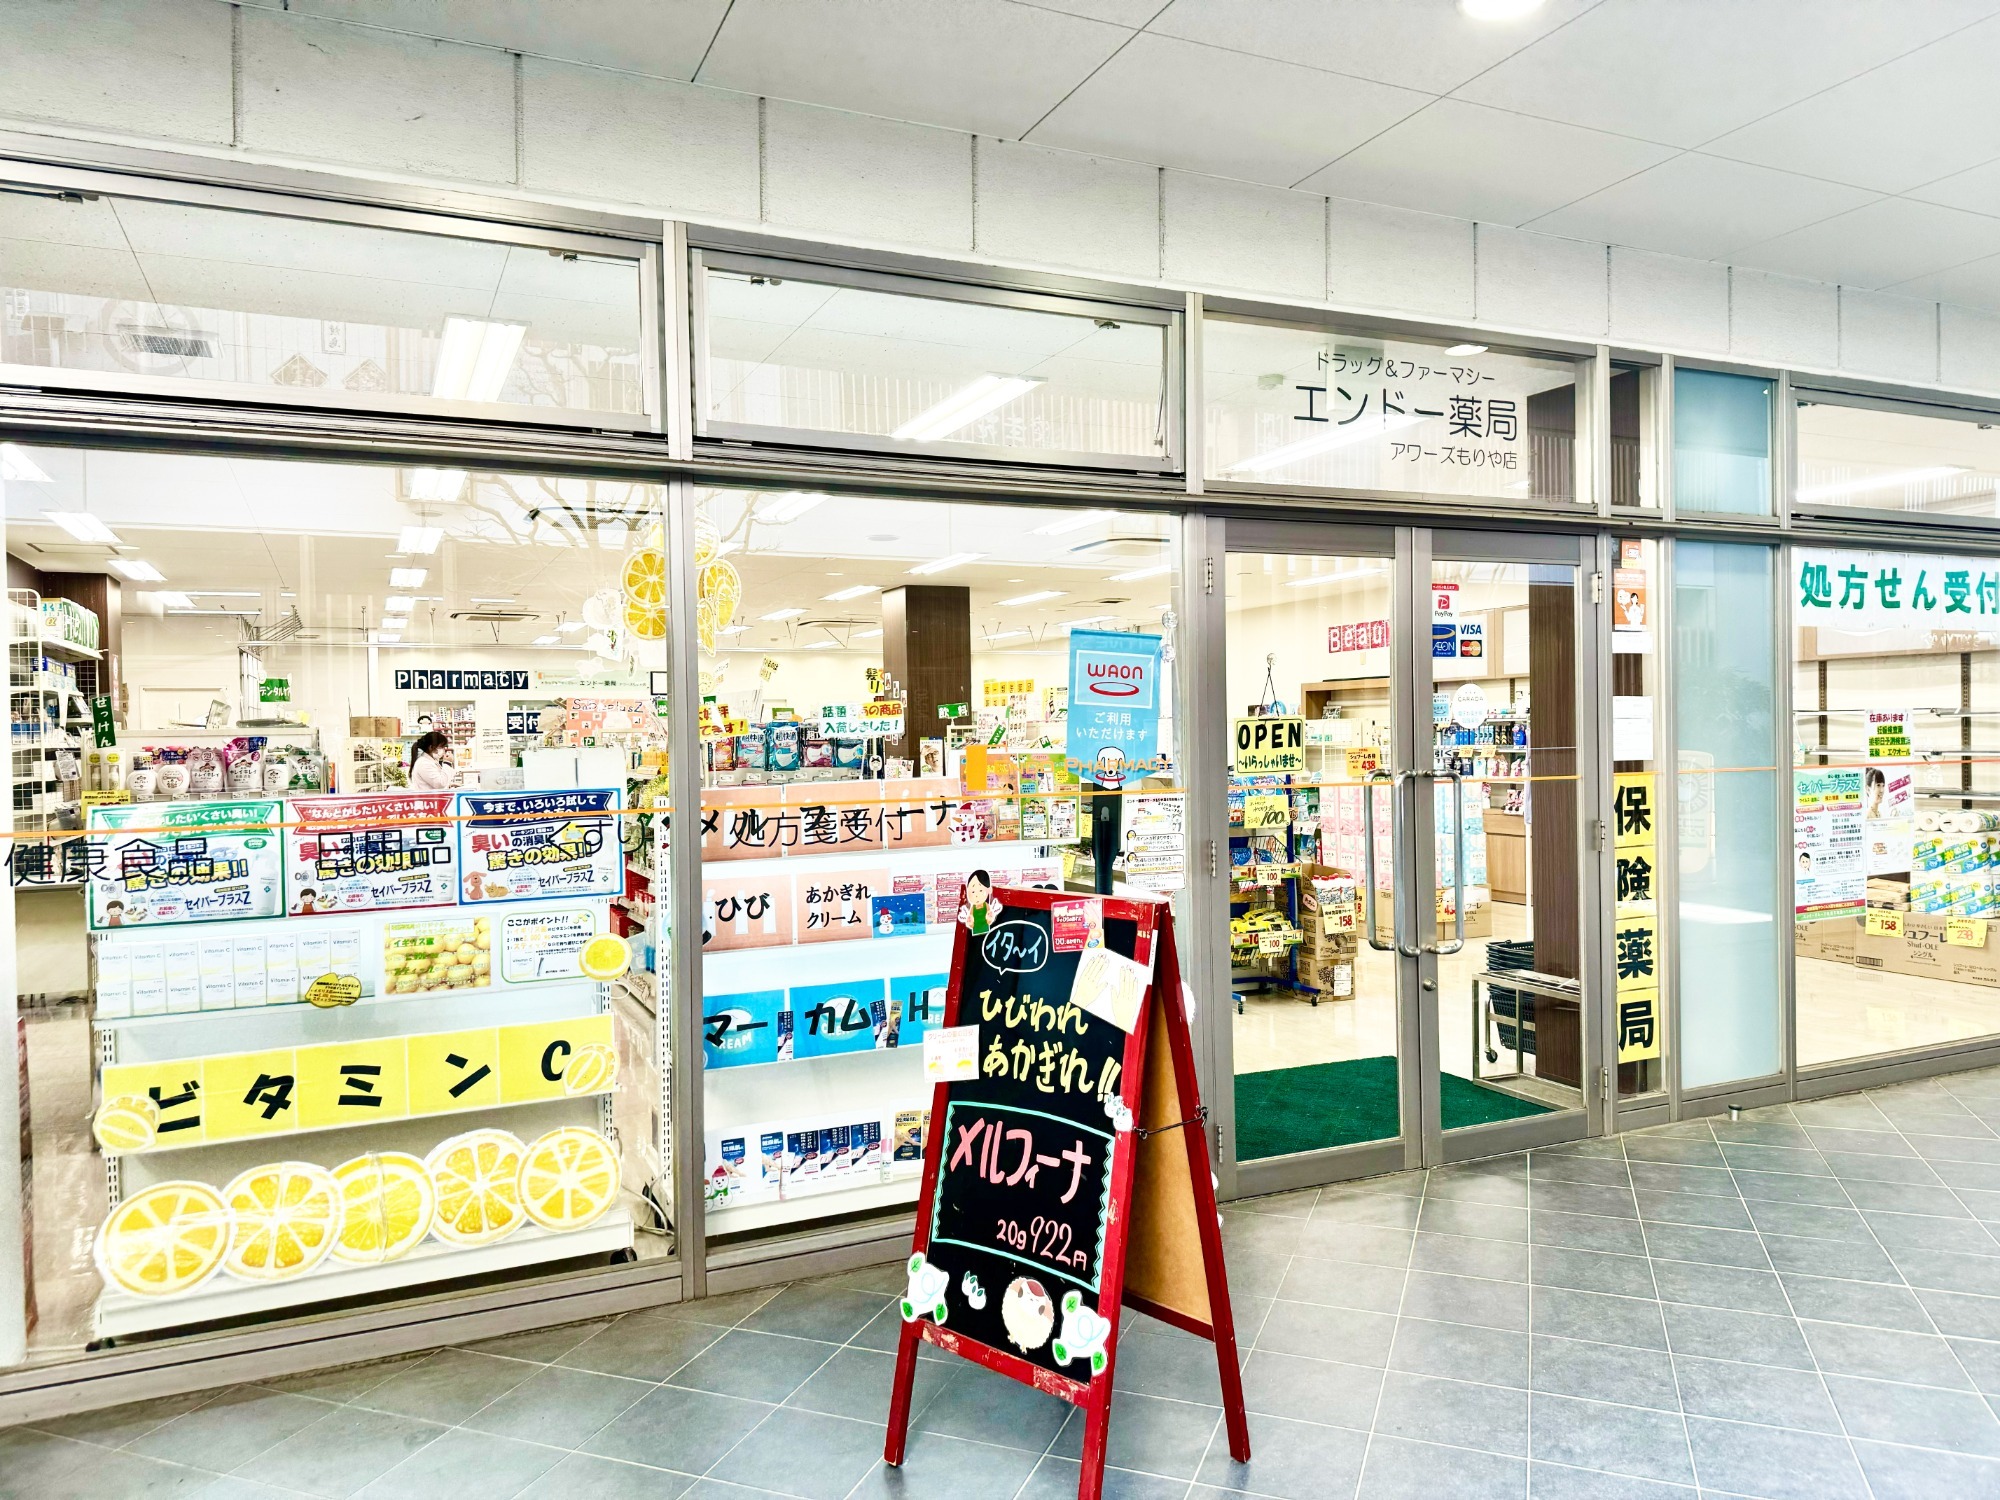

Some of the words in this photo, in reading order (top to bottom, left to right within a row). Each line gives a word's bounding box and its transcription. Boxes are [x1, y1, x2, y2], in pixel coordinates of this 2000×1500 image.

[1317, 351, 1495, 386] ドラッグ&ファーマシー
[1293, 385, 1518, 442] エンドー薬局
[1390, 442, 1518, 470] アワーズもりや店
[1434, 610, 1454, 618] PayPay
[1329, 622, 1391, 652] Beau
[1460, 624, 1482, 635] VISA
[397, 671, 528, 689] Pharmacy
[1087, 662, 1143, 680] WAON
[95, 697, 112, 747] せっけん
[1094, 711, 1132, 725] ご利用
[1076, 726, 1148, 741] いただけます
[1238, 722, 1302, 750] OPEN
[1361, 760, 1376, 770] 438
[318, 828, 452, 870] 日用品
[472, 833, 510, 853] 臭い
[549, 819, 645, 858] くすり
[4, 838, 215, 886] 健康食品
[1266, 873, 1278, 881] 100
[805, 883, 871, 904] あかぎれ
[806, 910, 861, 929] クリーム
[1338, 914, 1353, 928] 158
[1614, 785, 1655, 1051] 保険薬局
[1880, 919, 1897, 931] 158
[1269, 939, 1280, 948] 100
[1957, 929, 1974, 940] 238
[979, 988, 1089, 1036] ひびわれ
[149, 1039, 572, 1134] ビタミンC
[949, 1117, 1092, 1205] メルフィーナ
[996, 1217, 1027, 1250] 20g
[1030, 1215, 1088, 1271] 922円
